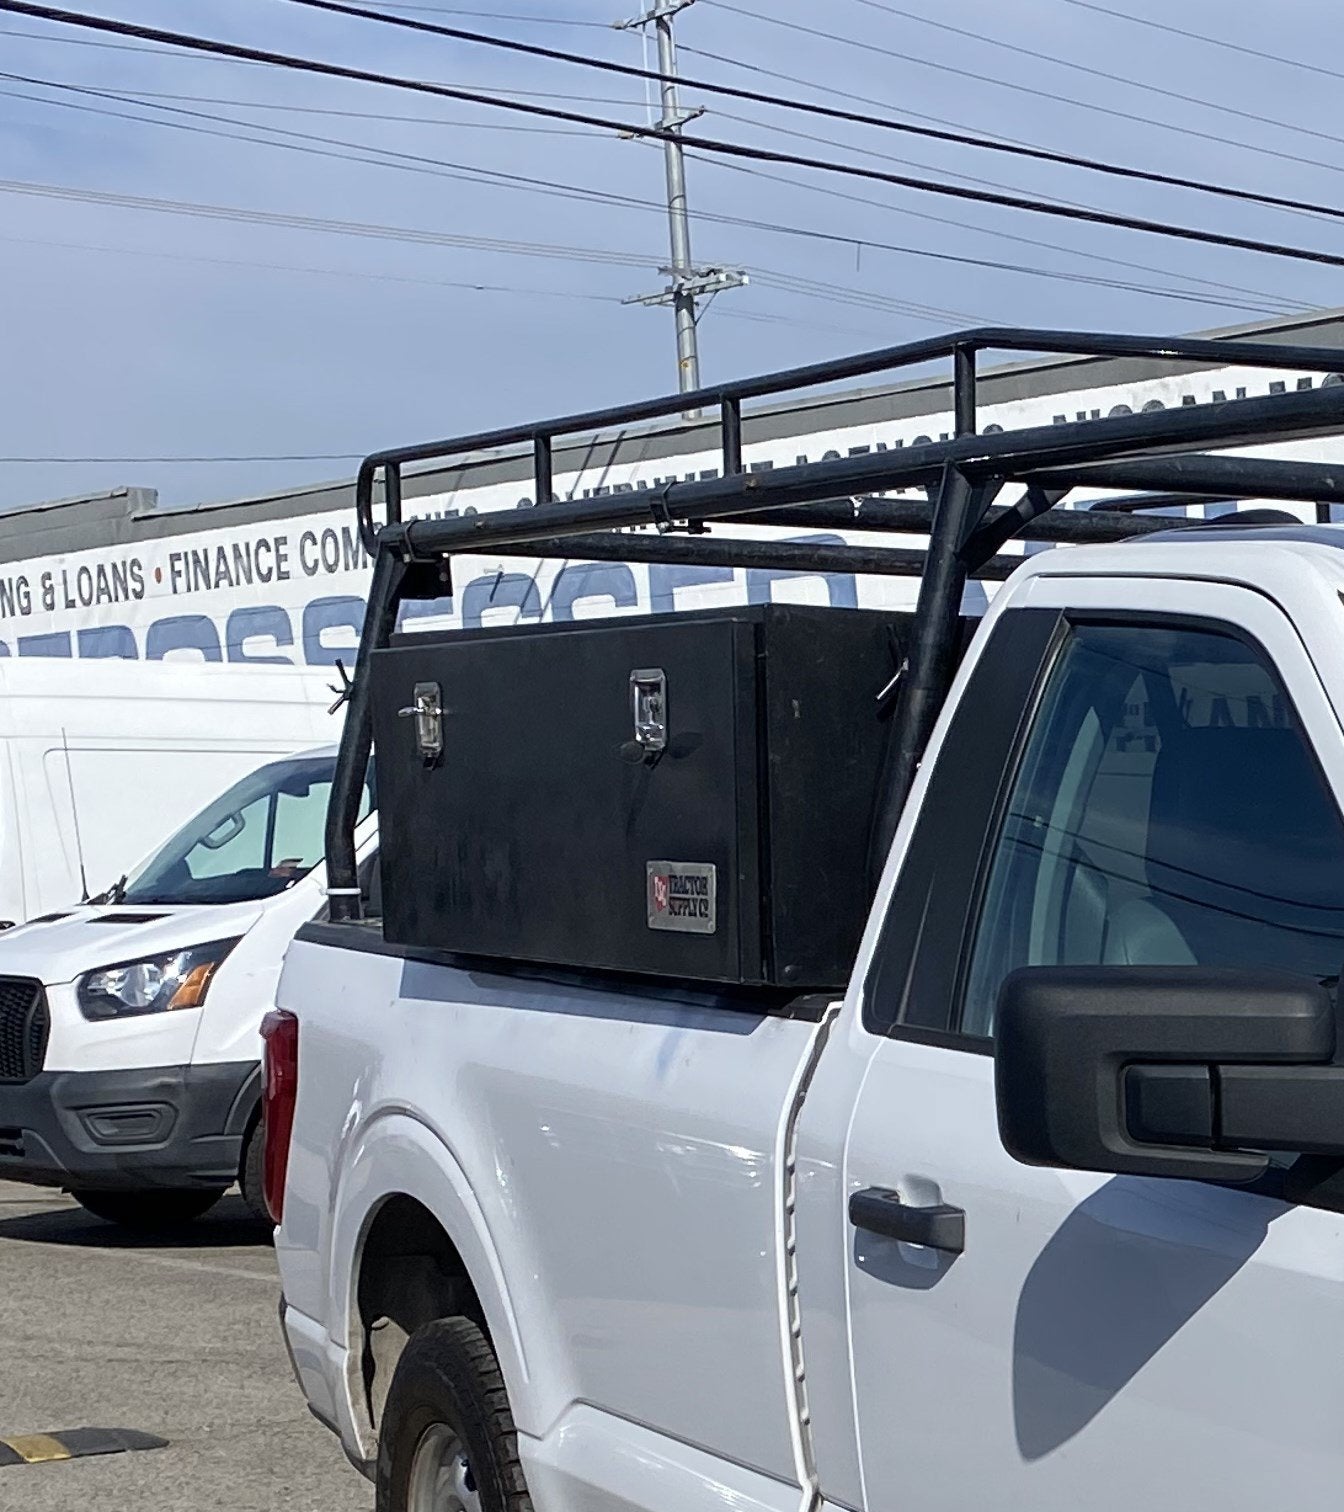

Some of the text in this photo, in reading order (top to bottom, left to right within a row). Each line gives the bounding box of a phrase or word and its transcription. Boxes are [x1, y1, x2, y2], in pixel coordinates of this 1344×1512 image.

[41, 571, 55, 611] &
[62, 557, 145, 609] LOANS
[169, 536, 290, 594] FINANCE
